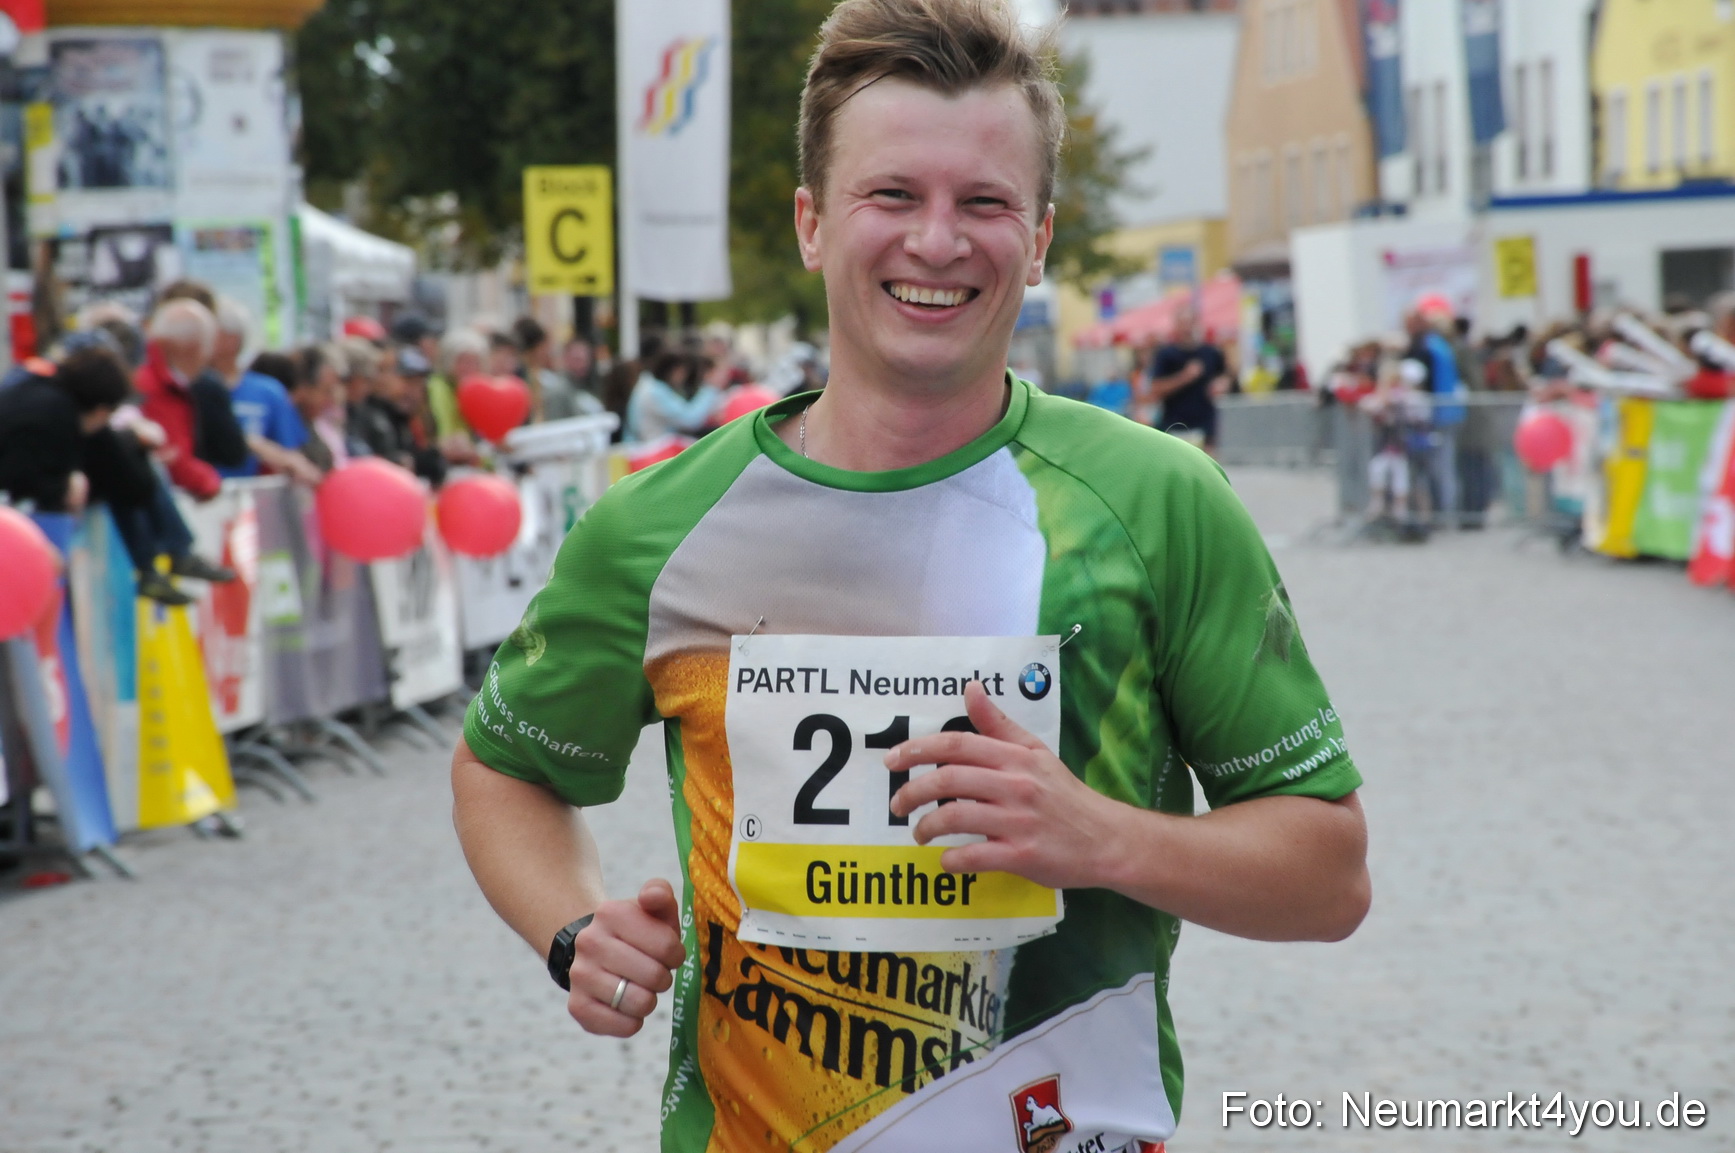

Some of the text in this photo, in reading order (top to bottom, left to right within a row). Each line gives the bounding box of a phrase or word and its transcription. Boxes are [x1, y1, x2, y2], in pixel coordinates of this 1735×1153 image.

[549, 208, 587, 263] C
[735, 667, 1005, 697] PARTL Neumarkt
[489, 660, 609, 762] Genuss schaffen.
[805, 860, 977, 906] Günther
